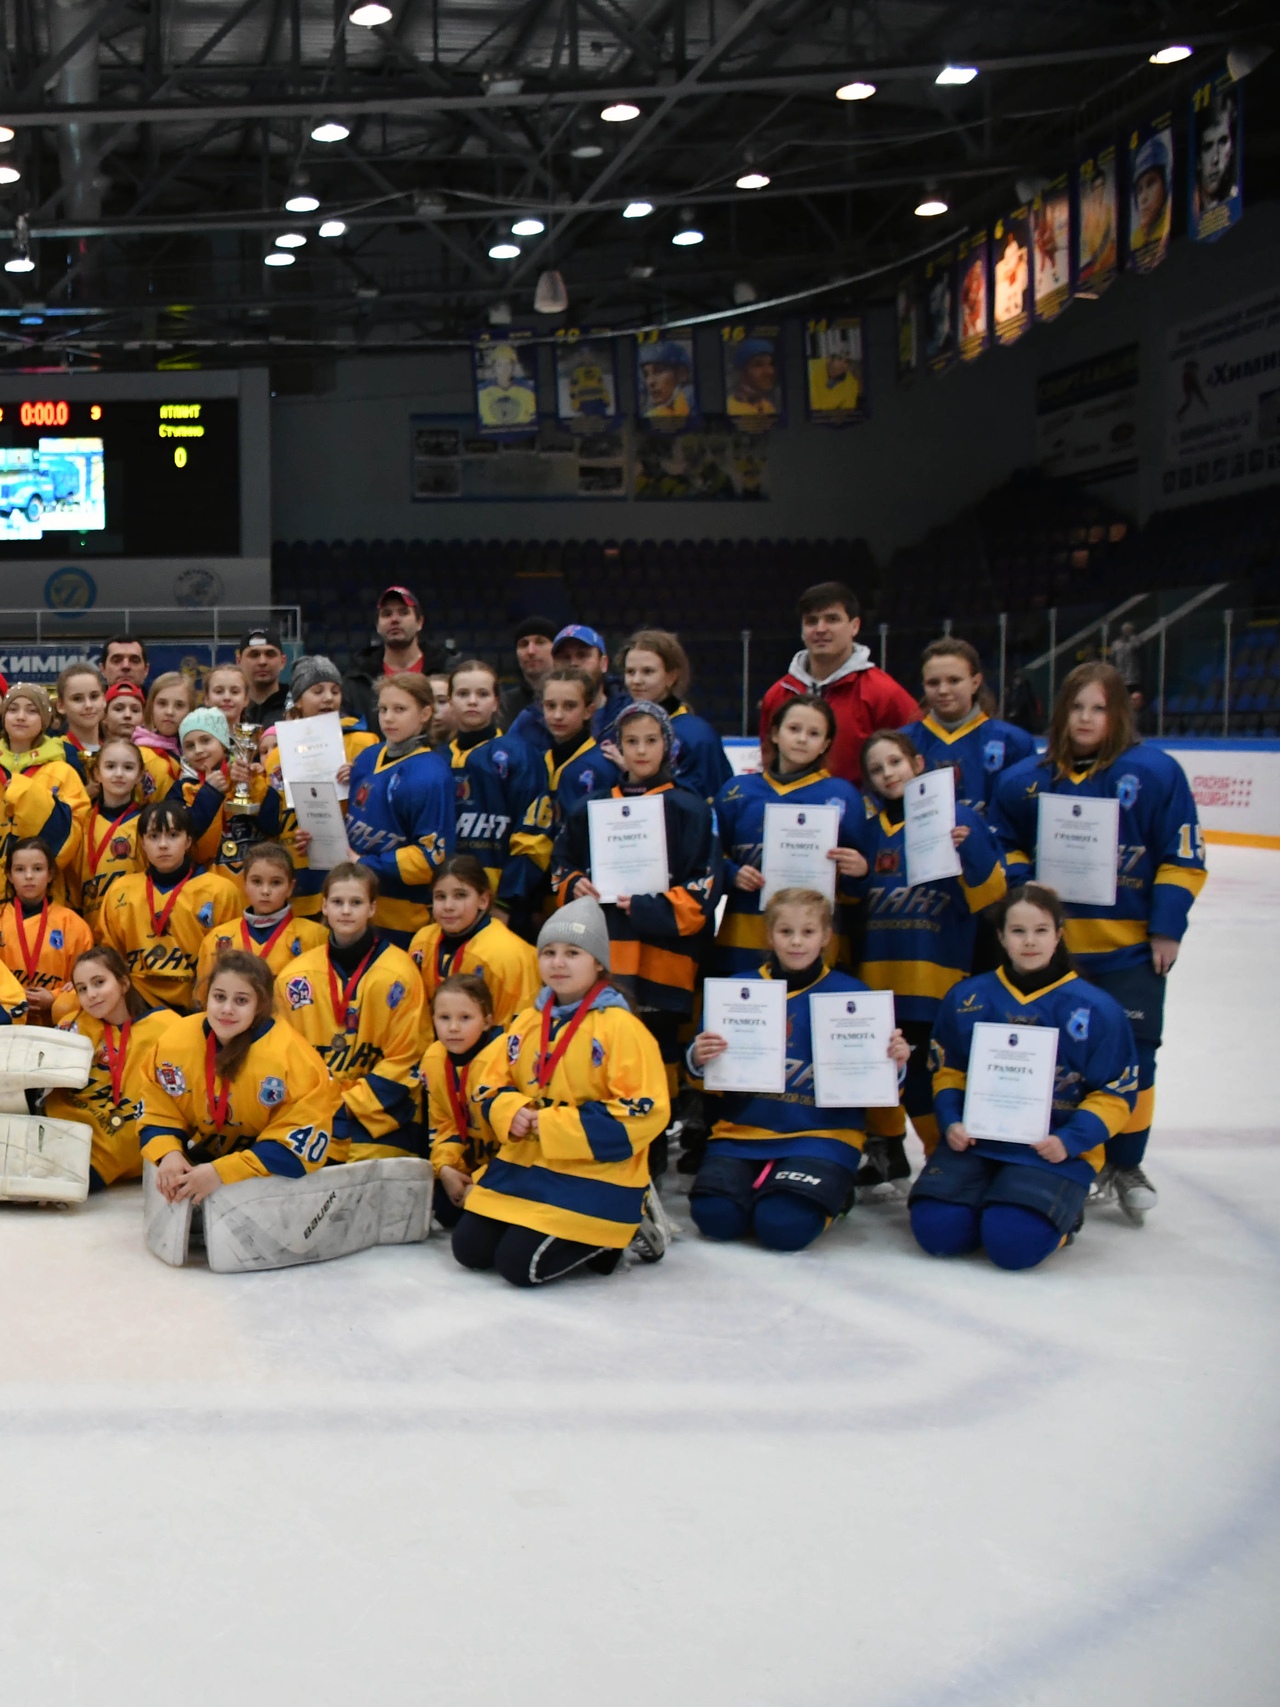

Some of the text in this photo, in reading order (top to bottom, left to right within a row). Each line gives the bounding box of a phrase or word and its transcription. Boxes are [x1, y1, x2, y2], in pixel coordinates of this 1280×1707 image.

[21, 401, 69, 427] 0:00.0
[91, 405, 102, 421] 3
[173, 446, 188, 469] 0
[286, 1124, 329, 1164] 40
[775, 1170, 822, 1186] CCM
